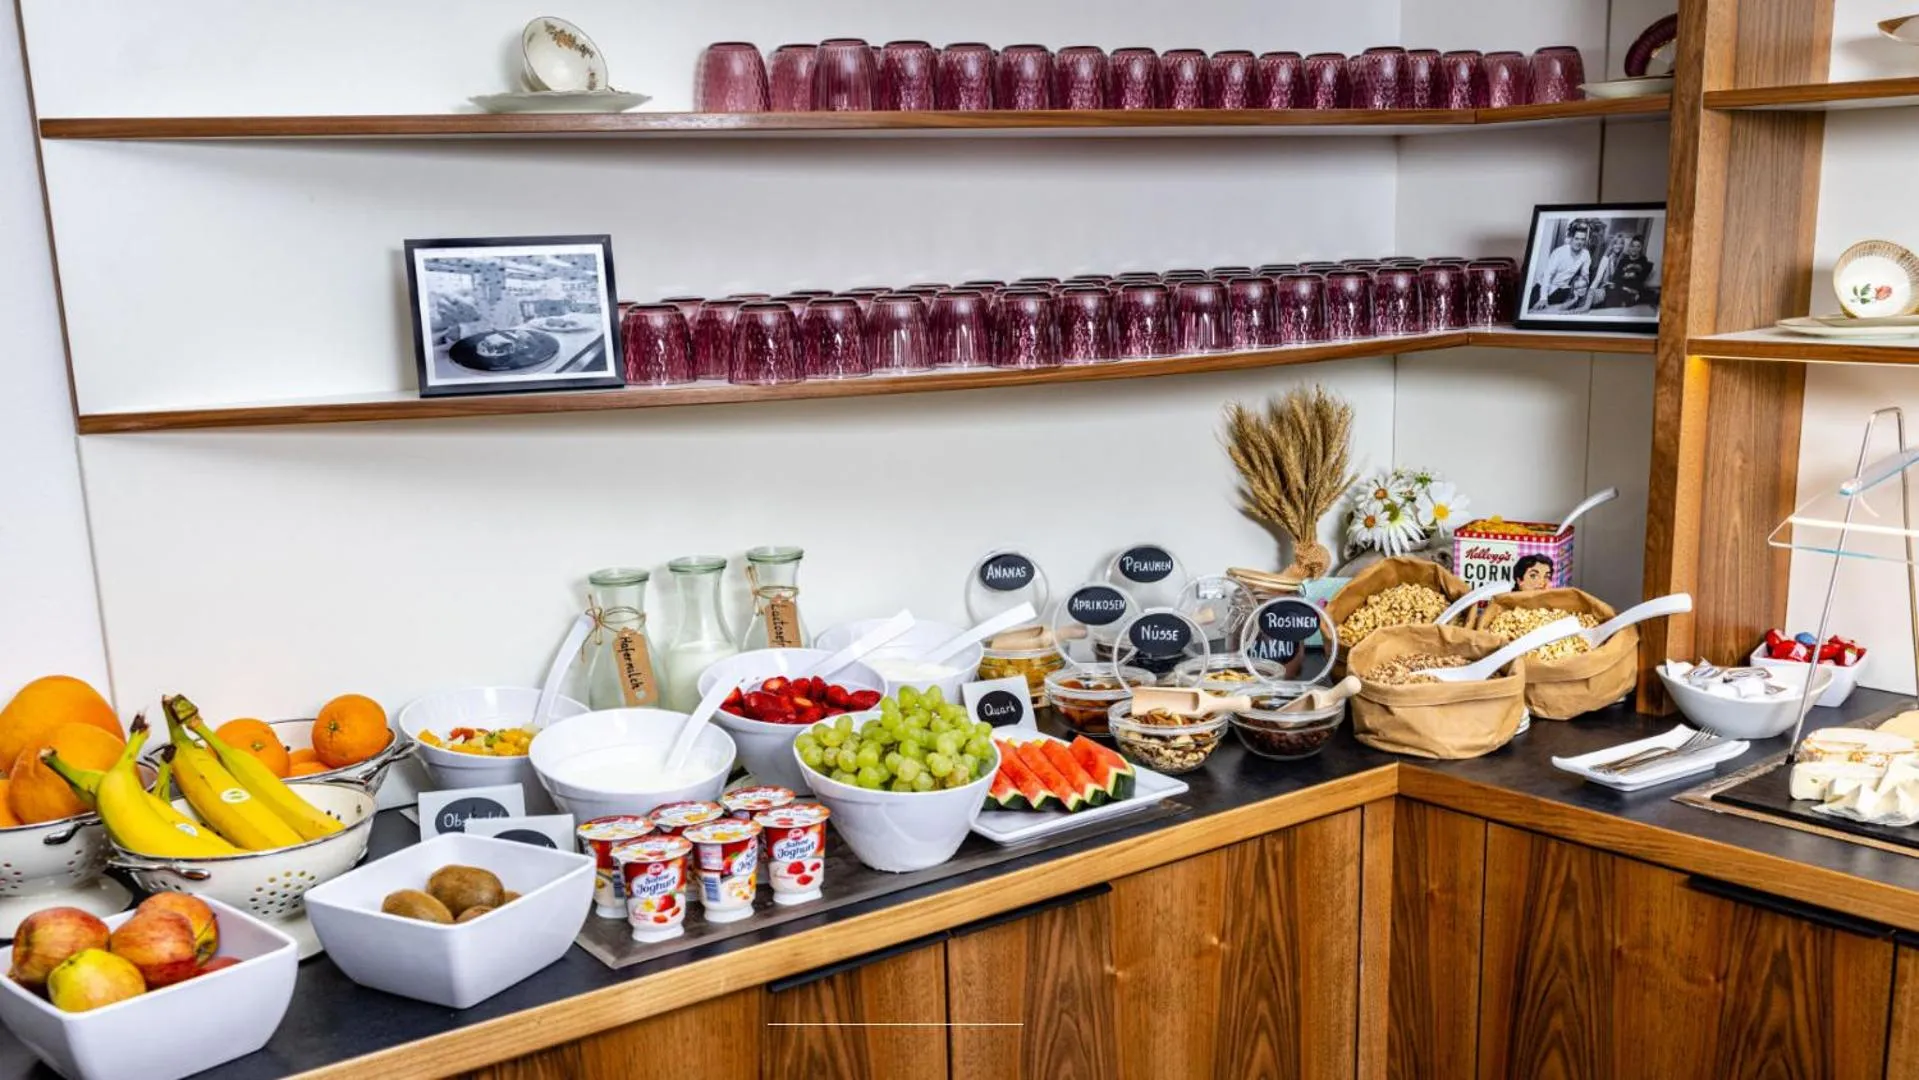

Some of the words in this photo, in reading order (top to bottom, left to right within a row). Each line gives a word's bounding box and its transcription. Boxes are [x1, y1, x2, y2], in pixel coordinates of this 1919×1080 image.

[986, 563, 1027, 581] ANANAS
[1464, 563, 1511, 581] CORN
[1072, 597, 1126, 612] APRIKOSEN
[1265, 613, 1318, 629] ROSINEN
[617, 636, 644, 690] Hafermilch
[984, 700, 1016, 717] Quark
[777, 841, 815, 859] Joghurt
[636, 876, 677, 897] Joghurt
